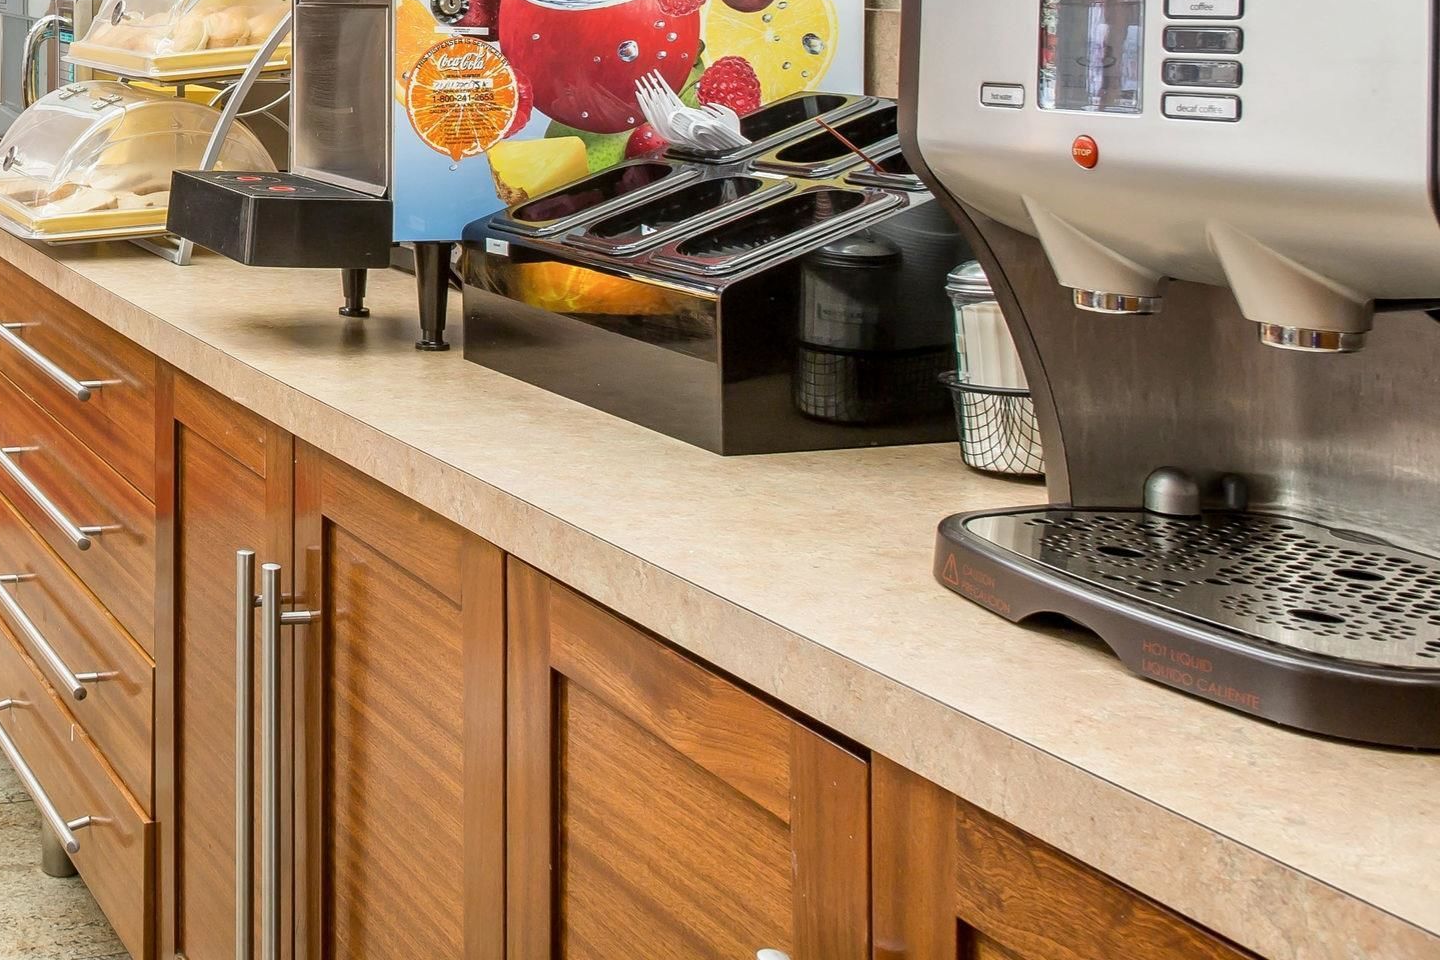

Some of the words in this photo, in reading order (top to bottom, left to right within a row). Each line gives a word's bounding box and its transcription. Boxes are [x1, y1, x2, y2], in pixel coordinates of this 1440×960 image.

[1189, 2, 1215, 11] coffee
[427, 38, 463, 58] DISPENSER
[432, 93, 495, 103] 1-800-241-2653
[1176, 103, 1198, 113] decaf
[1073, 147, 1091, 158] STOP
[1142, 640, 1168, 656] HOT
[1171, 650, 1213, 672] LIQUID
[1197, 679, 1260, 711] CALIENTE
